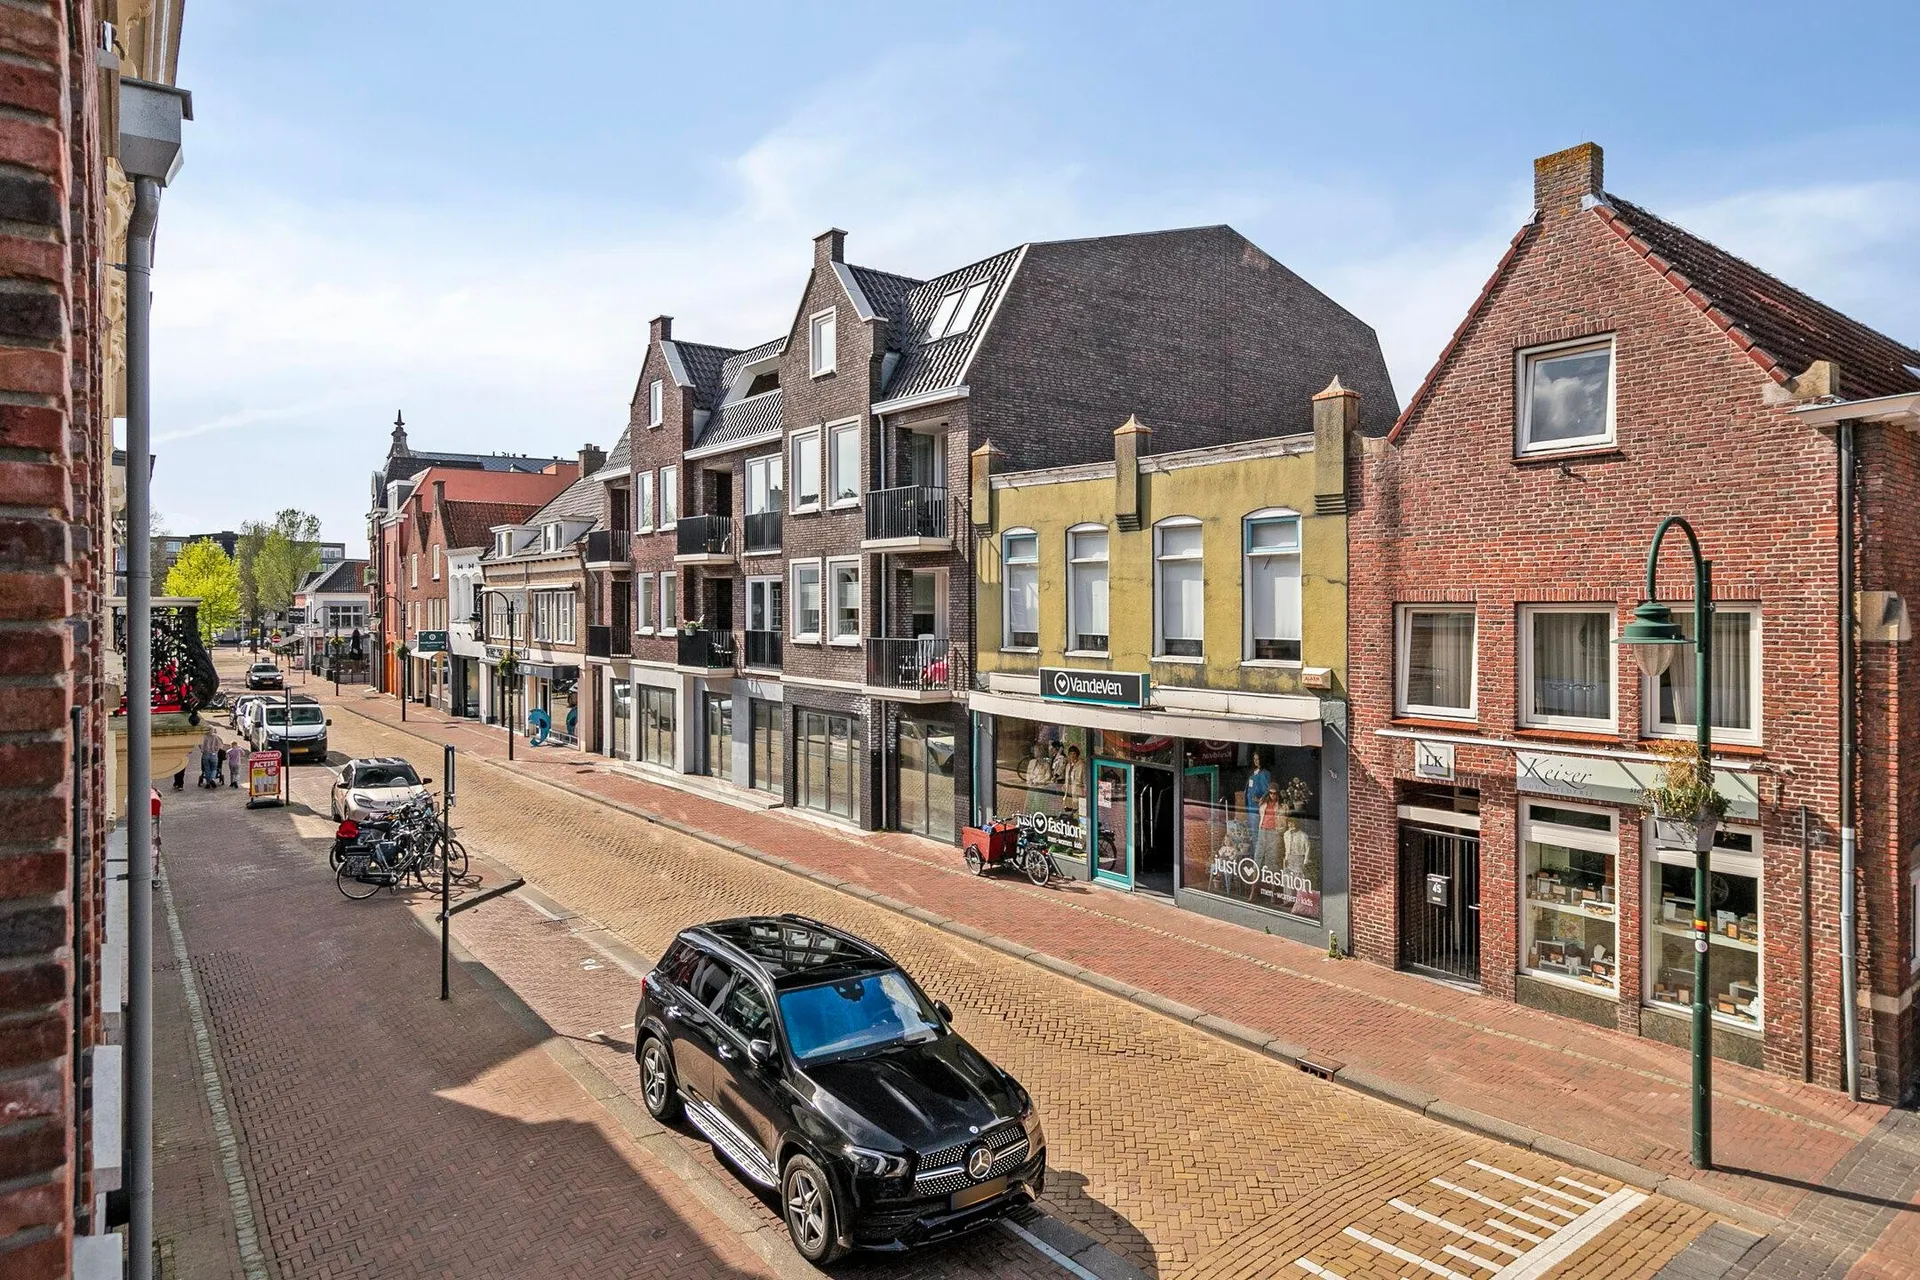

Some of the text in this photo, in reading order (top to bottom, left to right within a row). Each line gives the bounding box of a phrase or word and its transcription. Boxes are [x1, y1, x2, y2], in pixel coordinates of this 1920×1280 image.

[1069, 676, 1123, 696] VandeVen
[1425, 754, 1444, 768] LK
[1524, 757, 1592, 789] Keizer
[1016, 813, 1083, 839] just fashion
[1213, 854, 1313, 894] just fashion
[1260, 888, 1274, 897] men
[1277, 892, 1297, 903] women
